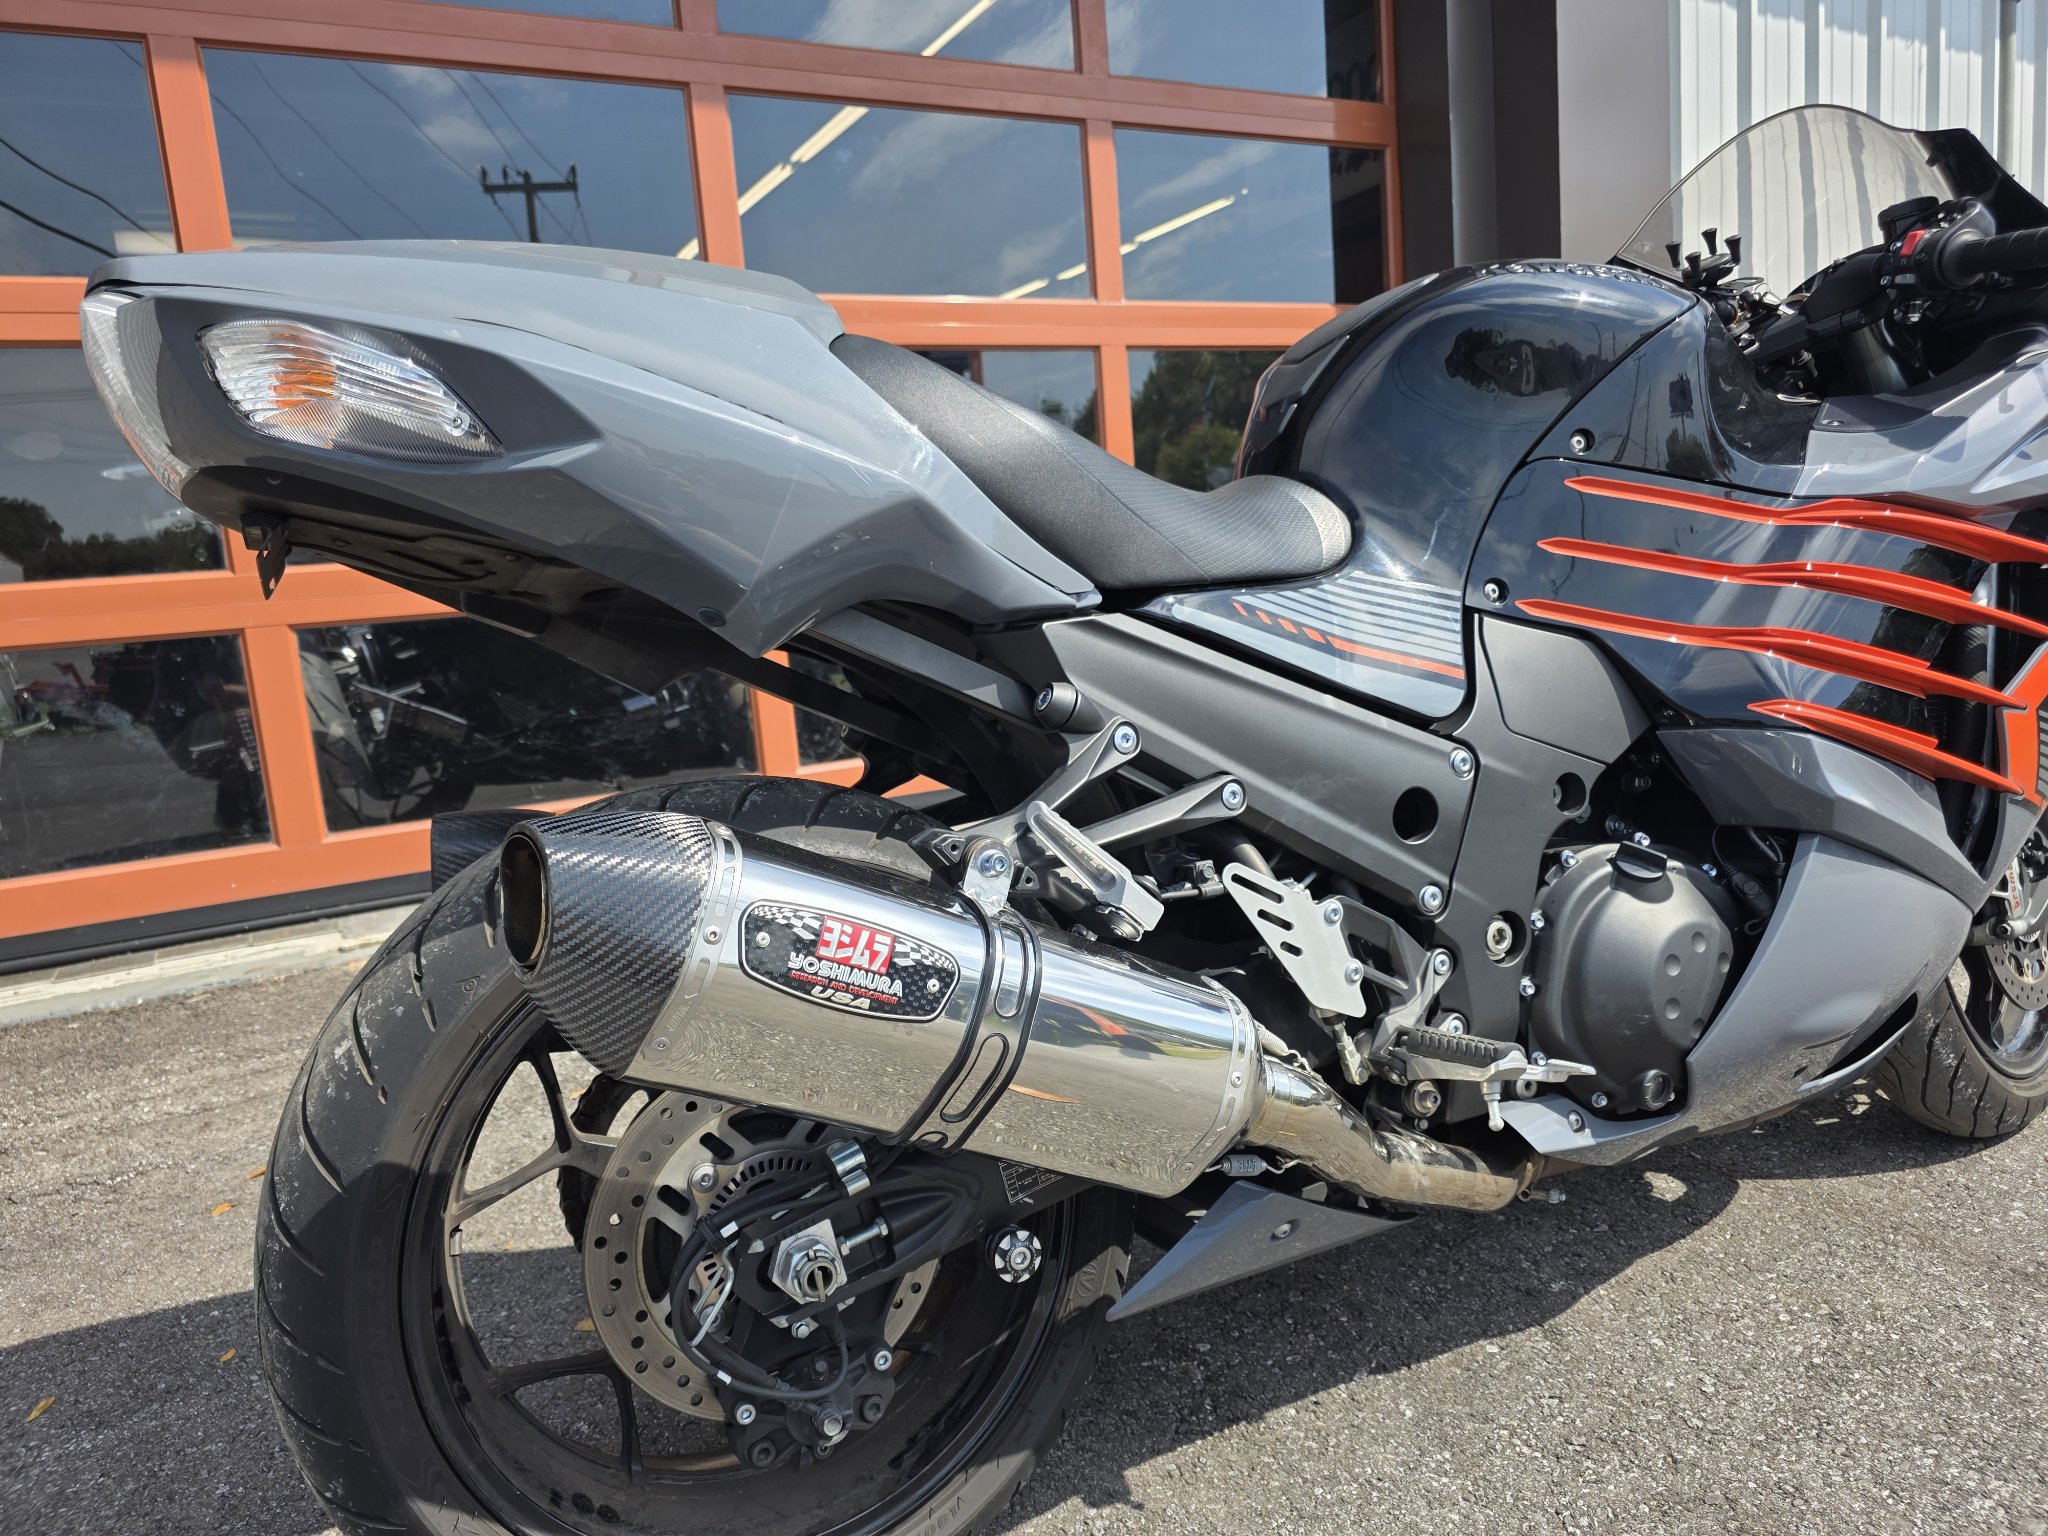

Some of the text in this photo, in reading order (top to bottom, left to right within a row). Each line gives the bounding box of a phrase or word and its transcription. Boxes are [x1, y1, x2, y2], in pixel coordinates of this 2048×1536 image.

[819, 920, 891, 971] ヨシムラ
[788, 951, 903, 998] YOSHIMURA
[790, 970, 899, 1005] RESEARCH AND DEVELOPMENT
[811, 985, 871, 1010] USA
